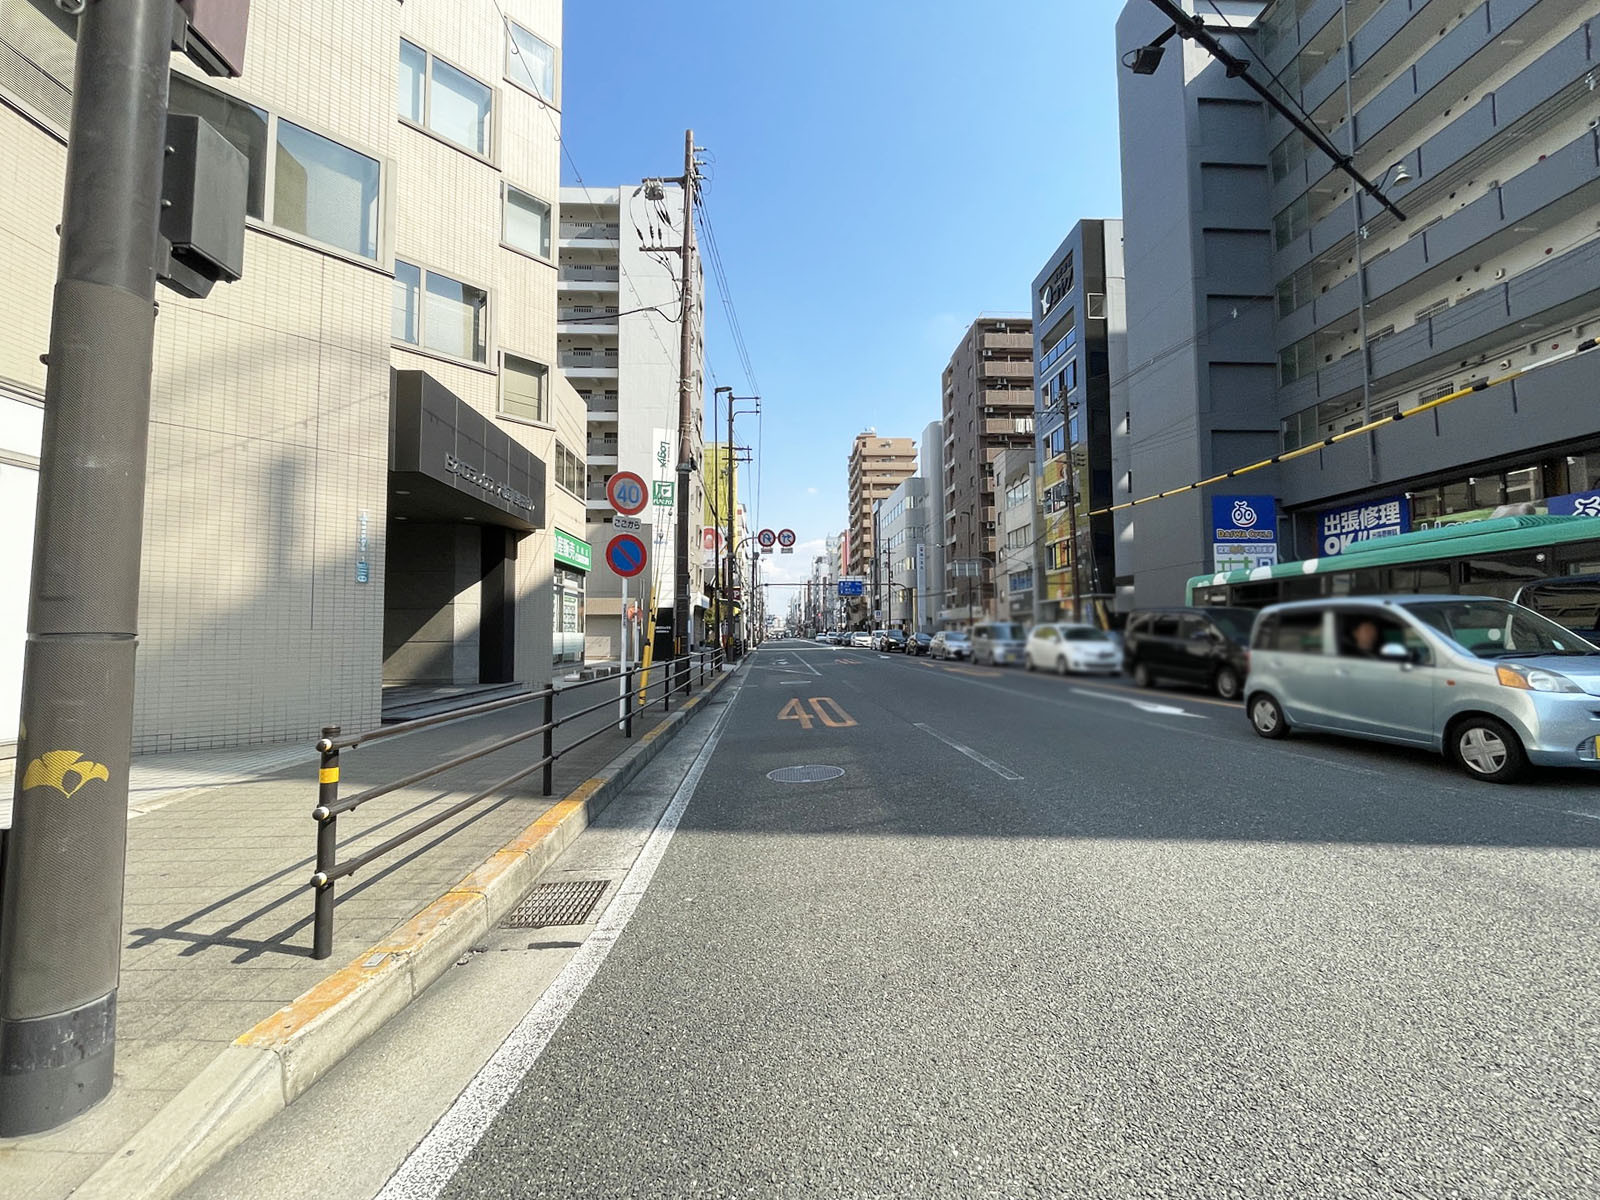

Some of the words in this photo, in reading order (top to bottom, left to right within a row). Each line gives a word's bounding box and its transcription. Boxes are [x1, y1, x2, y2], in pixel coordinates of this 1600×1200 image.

[617, 483, 640, 504] 40
[614, 519, 640, 530] ここから
[1324, 501, 1400, 536] 出張修理
[777, 697, 858, 729] 40
